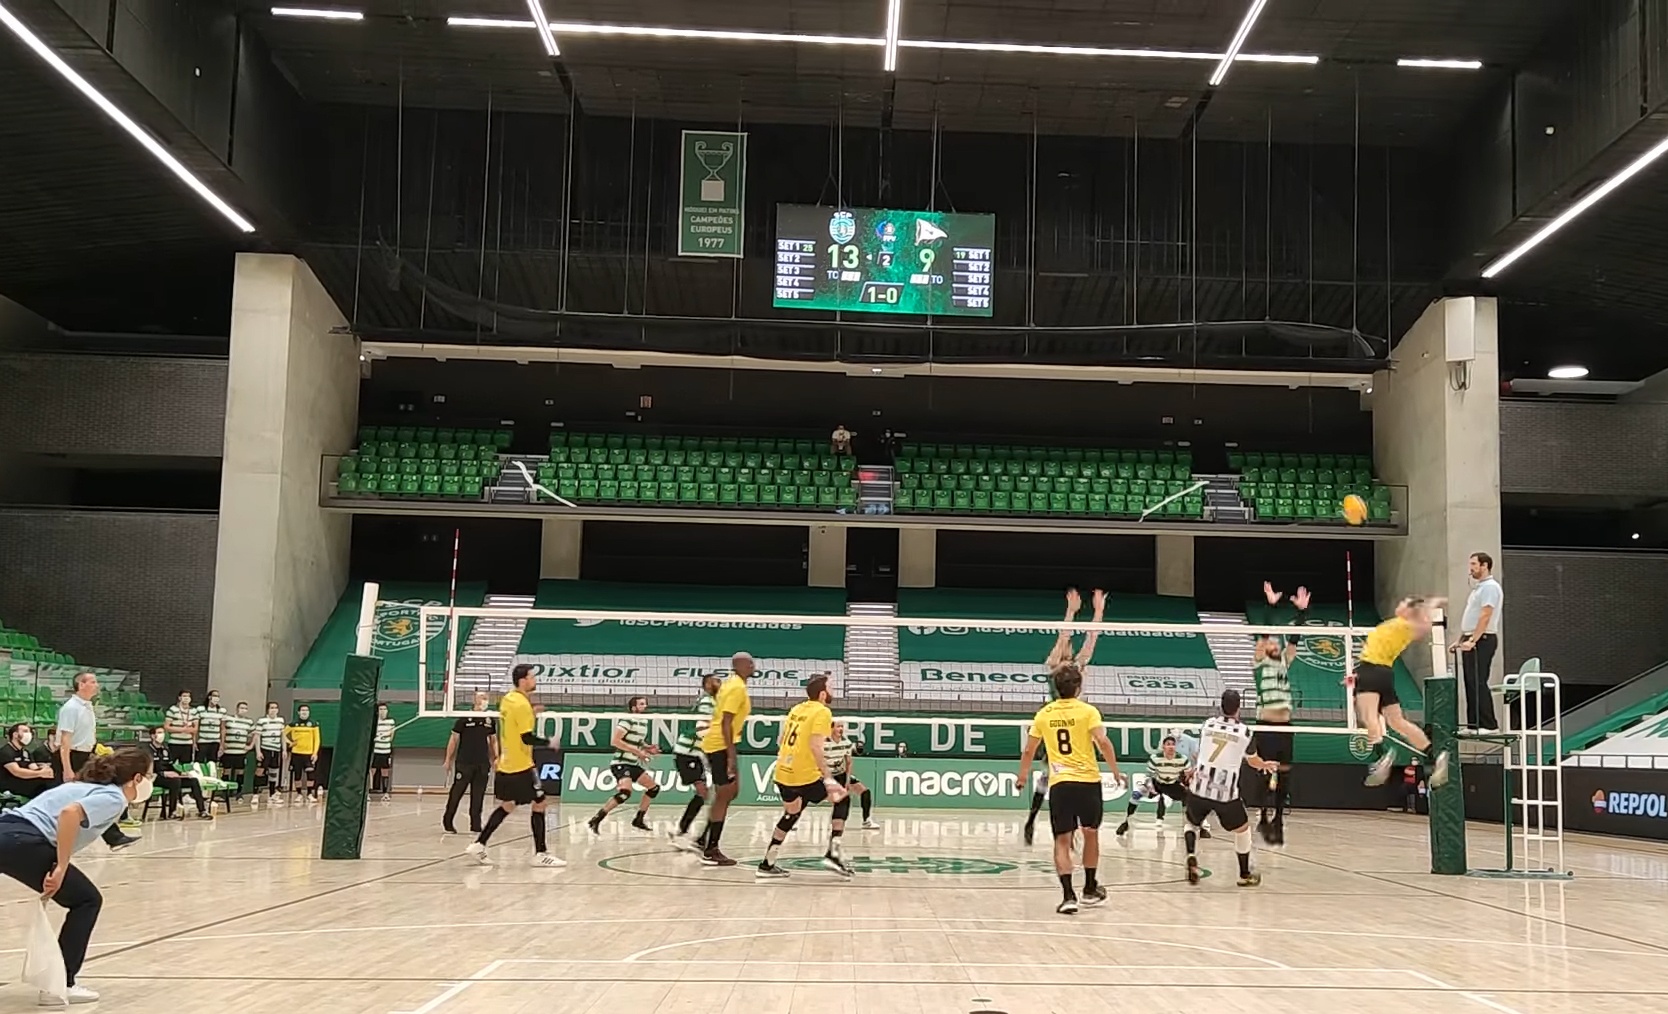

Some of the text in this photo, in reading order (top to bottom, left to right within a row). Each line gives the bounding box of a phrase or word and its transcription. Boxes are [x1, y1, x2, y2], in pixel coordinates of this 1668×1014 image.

[690, 215, 733, 224] CAMPEÕES
[690, 225, 733, 234] EUROPEUS
[698, 237, 725, 248] 1977
[802, 244, 814, 252] 25
[777, 254, 793, 262] SET
[827, 244, 859, 269] 13
[955, 251, 966, 259] 19
[882, 254, 891, 266] 2
[919, 248, 936, 272] 9
[776, 266, 793, 274] SET
[968, 263, 984, 271] SET
[776, 278, 792, 286] SET
[931, 275, 944, 284] TO
[967, 275, 983, 283] SET
[776, 290, 792, 298] SET
[867, 286, 898, 303] 1-0
[967, 287, 983, 295] SET
[967, 299, 982, 307] SET
[532, 663, 640, 678] Dixtior
[673, 667, 799, 680] FILSONE
[1128, 680, 1194, 689] casa
[931, 718, 986, 752] DE
[1056, 728, 1073, 755] 8
[1208, 738, 1228, 763] 7
[1608, 791, 1668, 817] REPSOL
